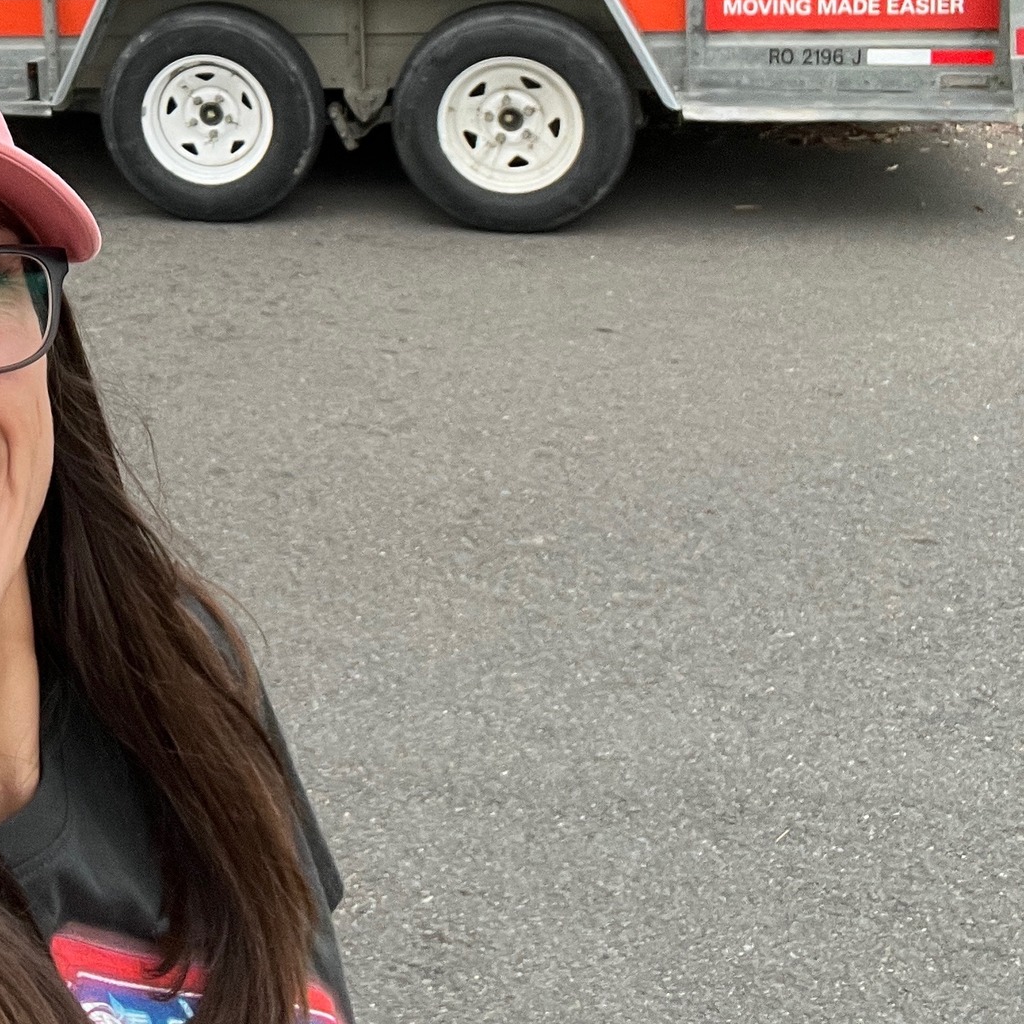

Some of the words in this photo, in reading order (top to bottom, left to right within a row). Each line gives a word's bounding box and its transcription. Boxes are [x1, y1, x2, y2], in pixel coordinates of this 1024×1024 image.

[768, 48, 795, 66] RO
[802, 48, 844, 66] 2196
[852, 48, 862, 66] J
